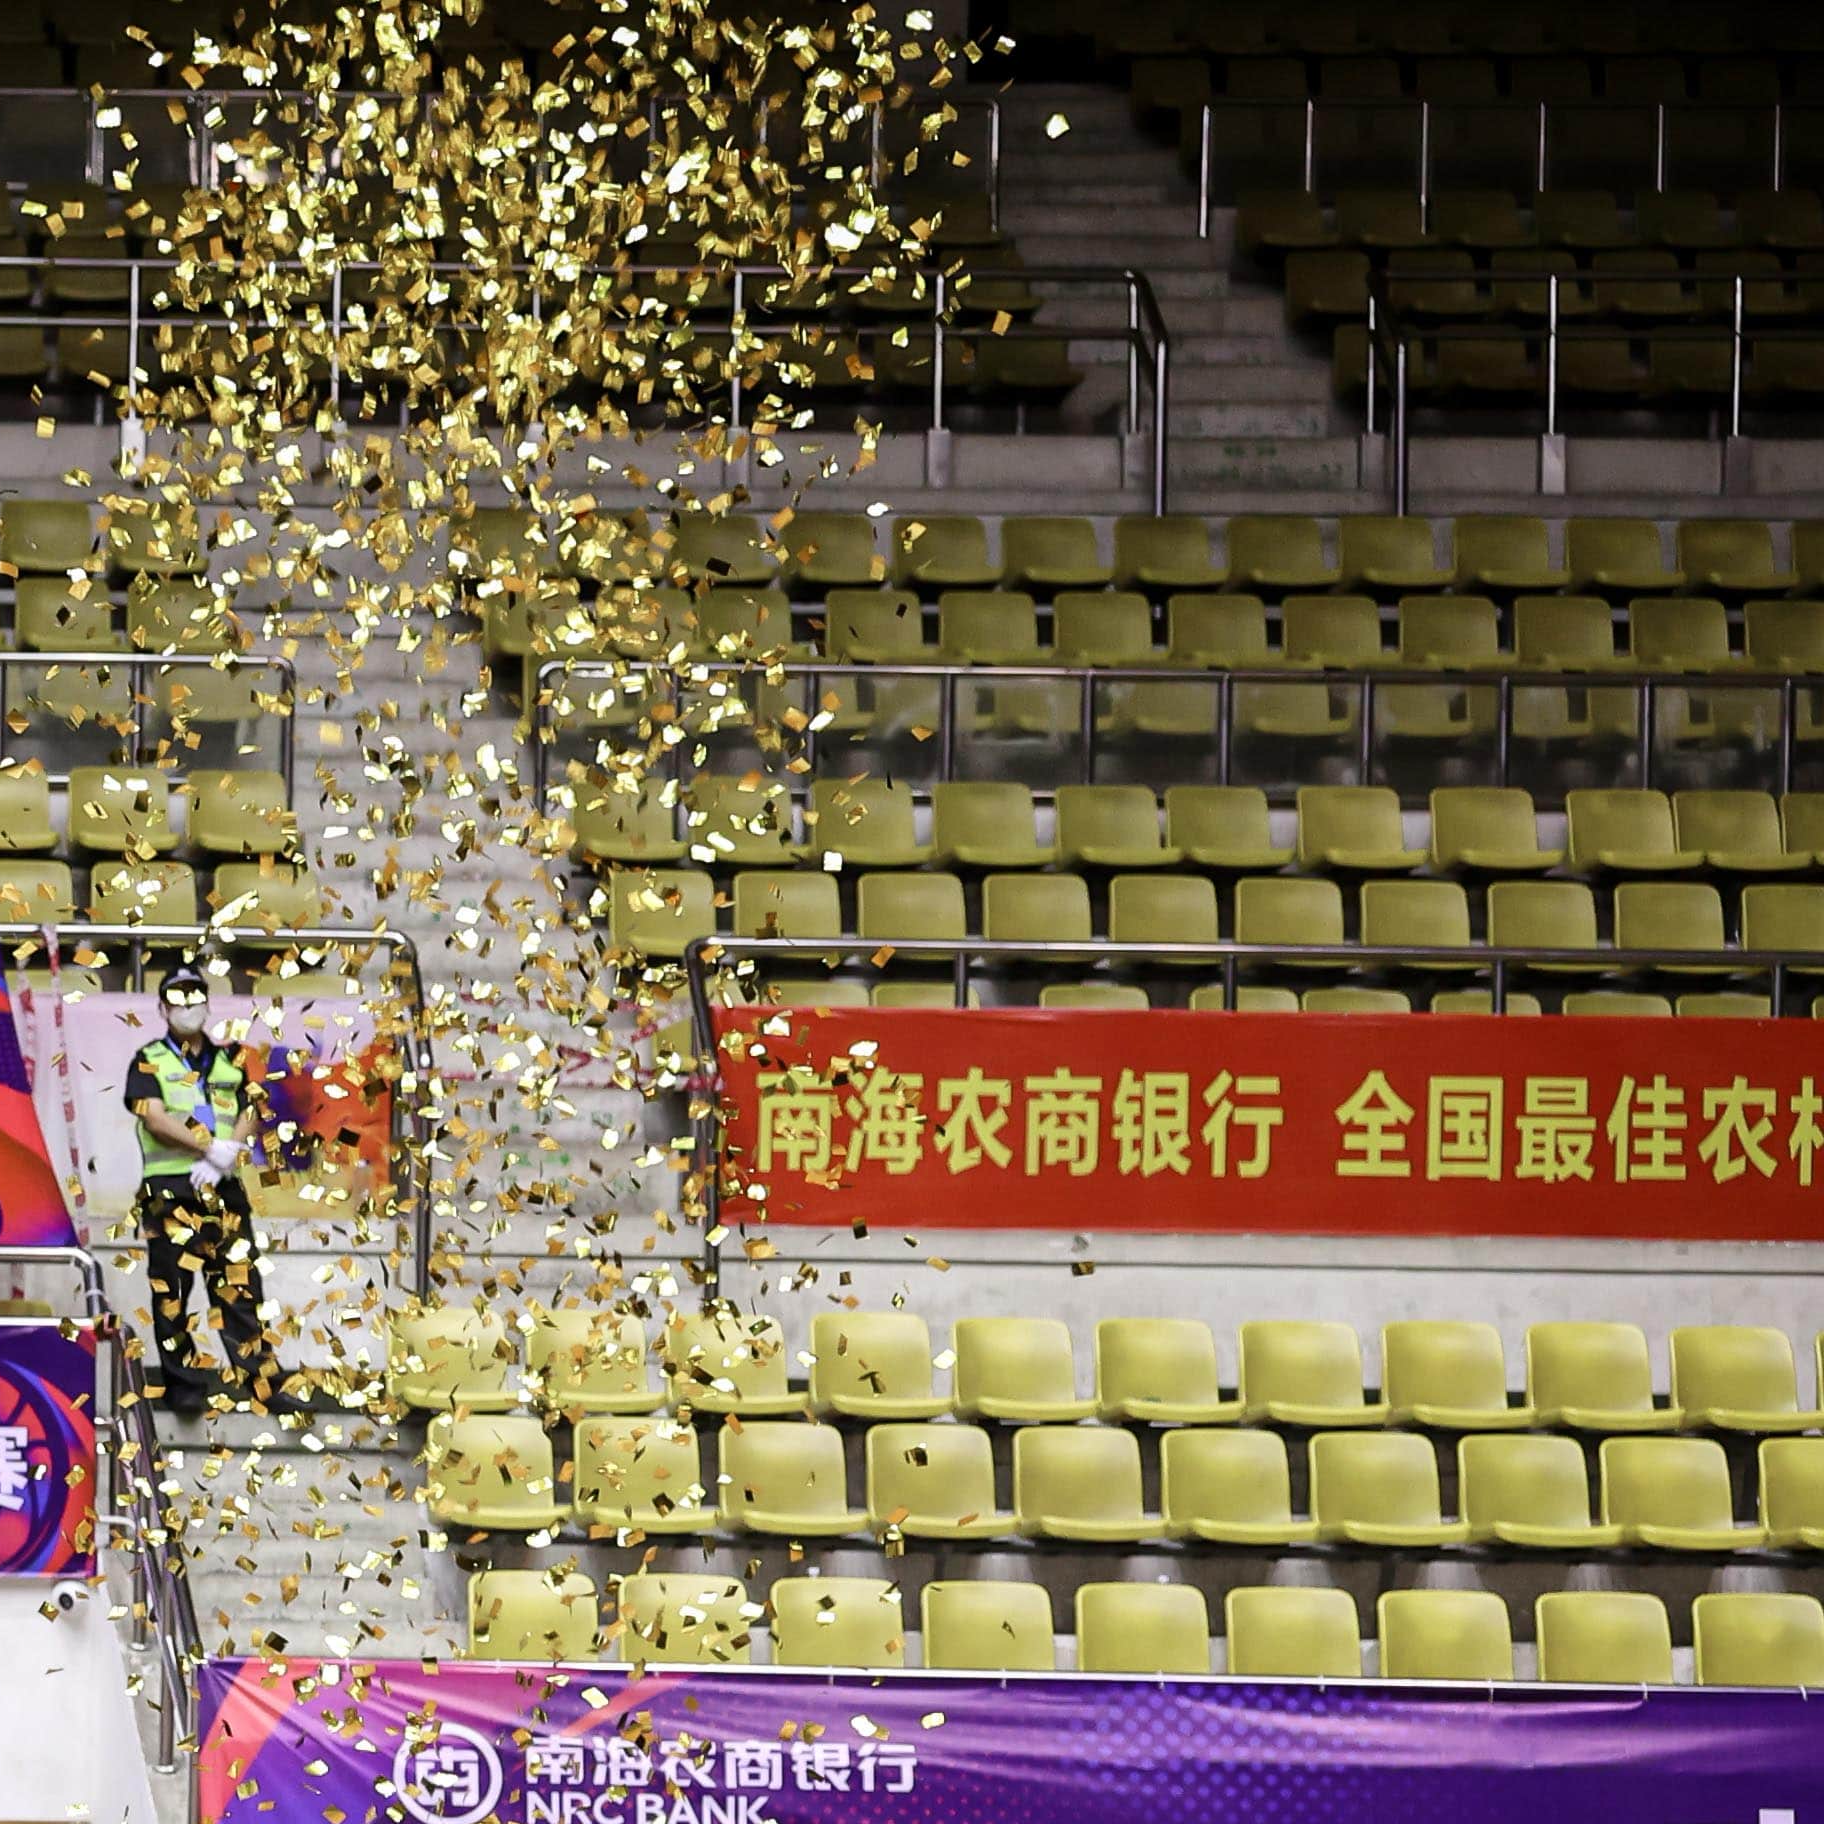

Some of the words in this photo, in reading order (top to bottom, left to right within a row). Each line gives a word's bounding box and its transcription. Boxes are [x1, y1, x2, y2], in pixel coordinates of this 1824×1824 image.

[755, 1067, 1285, 1180] 南海农商银行
[525, 1735, 919, 1795] 南海农商银行
